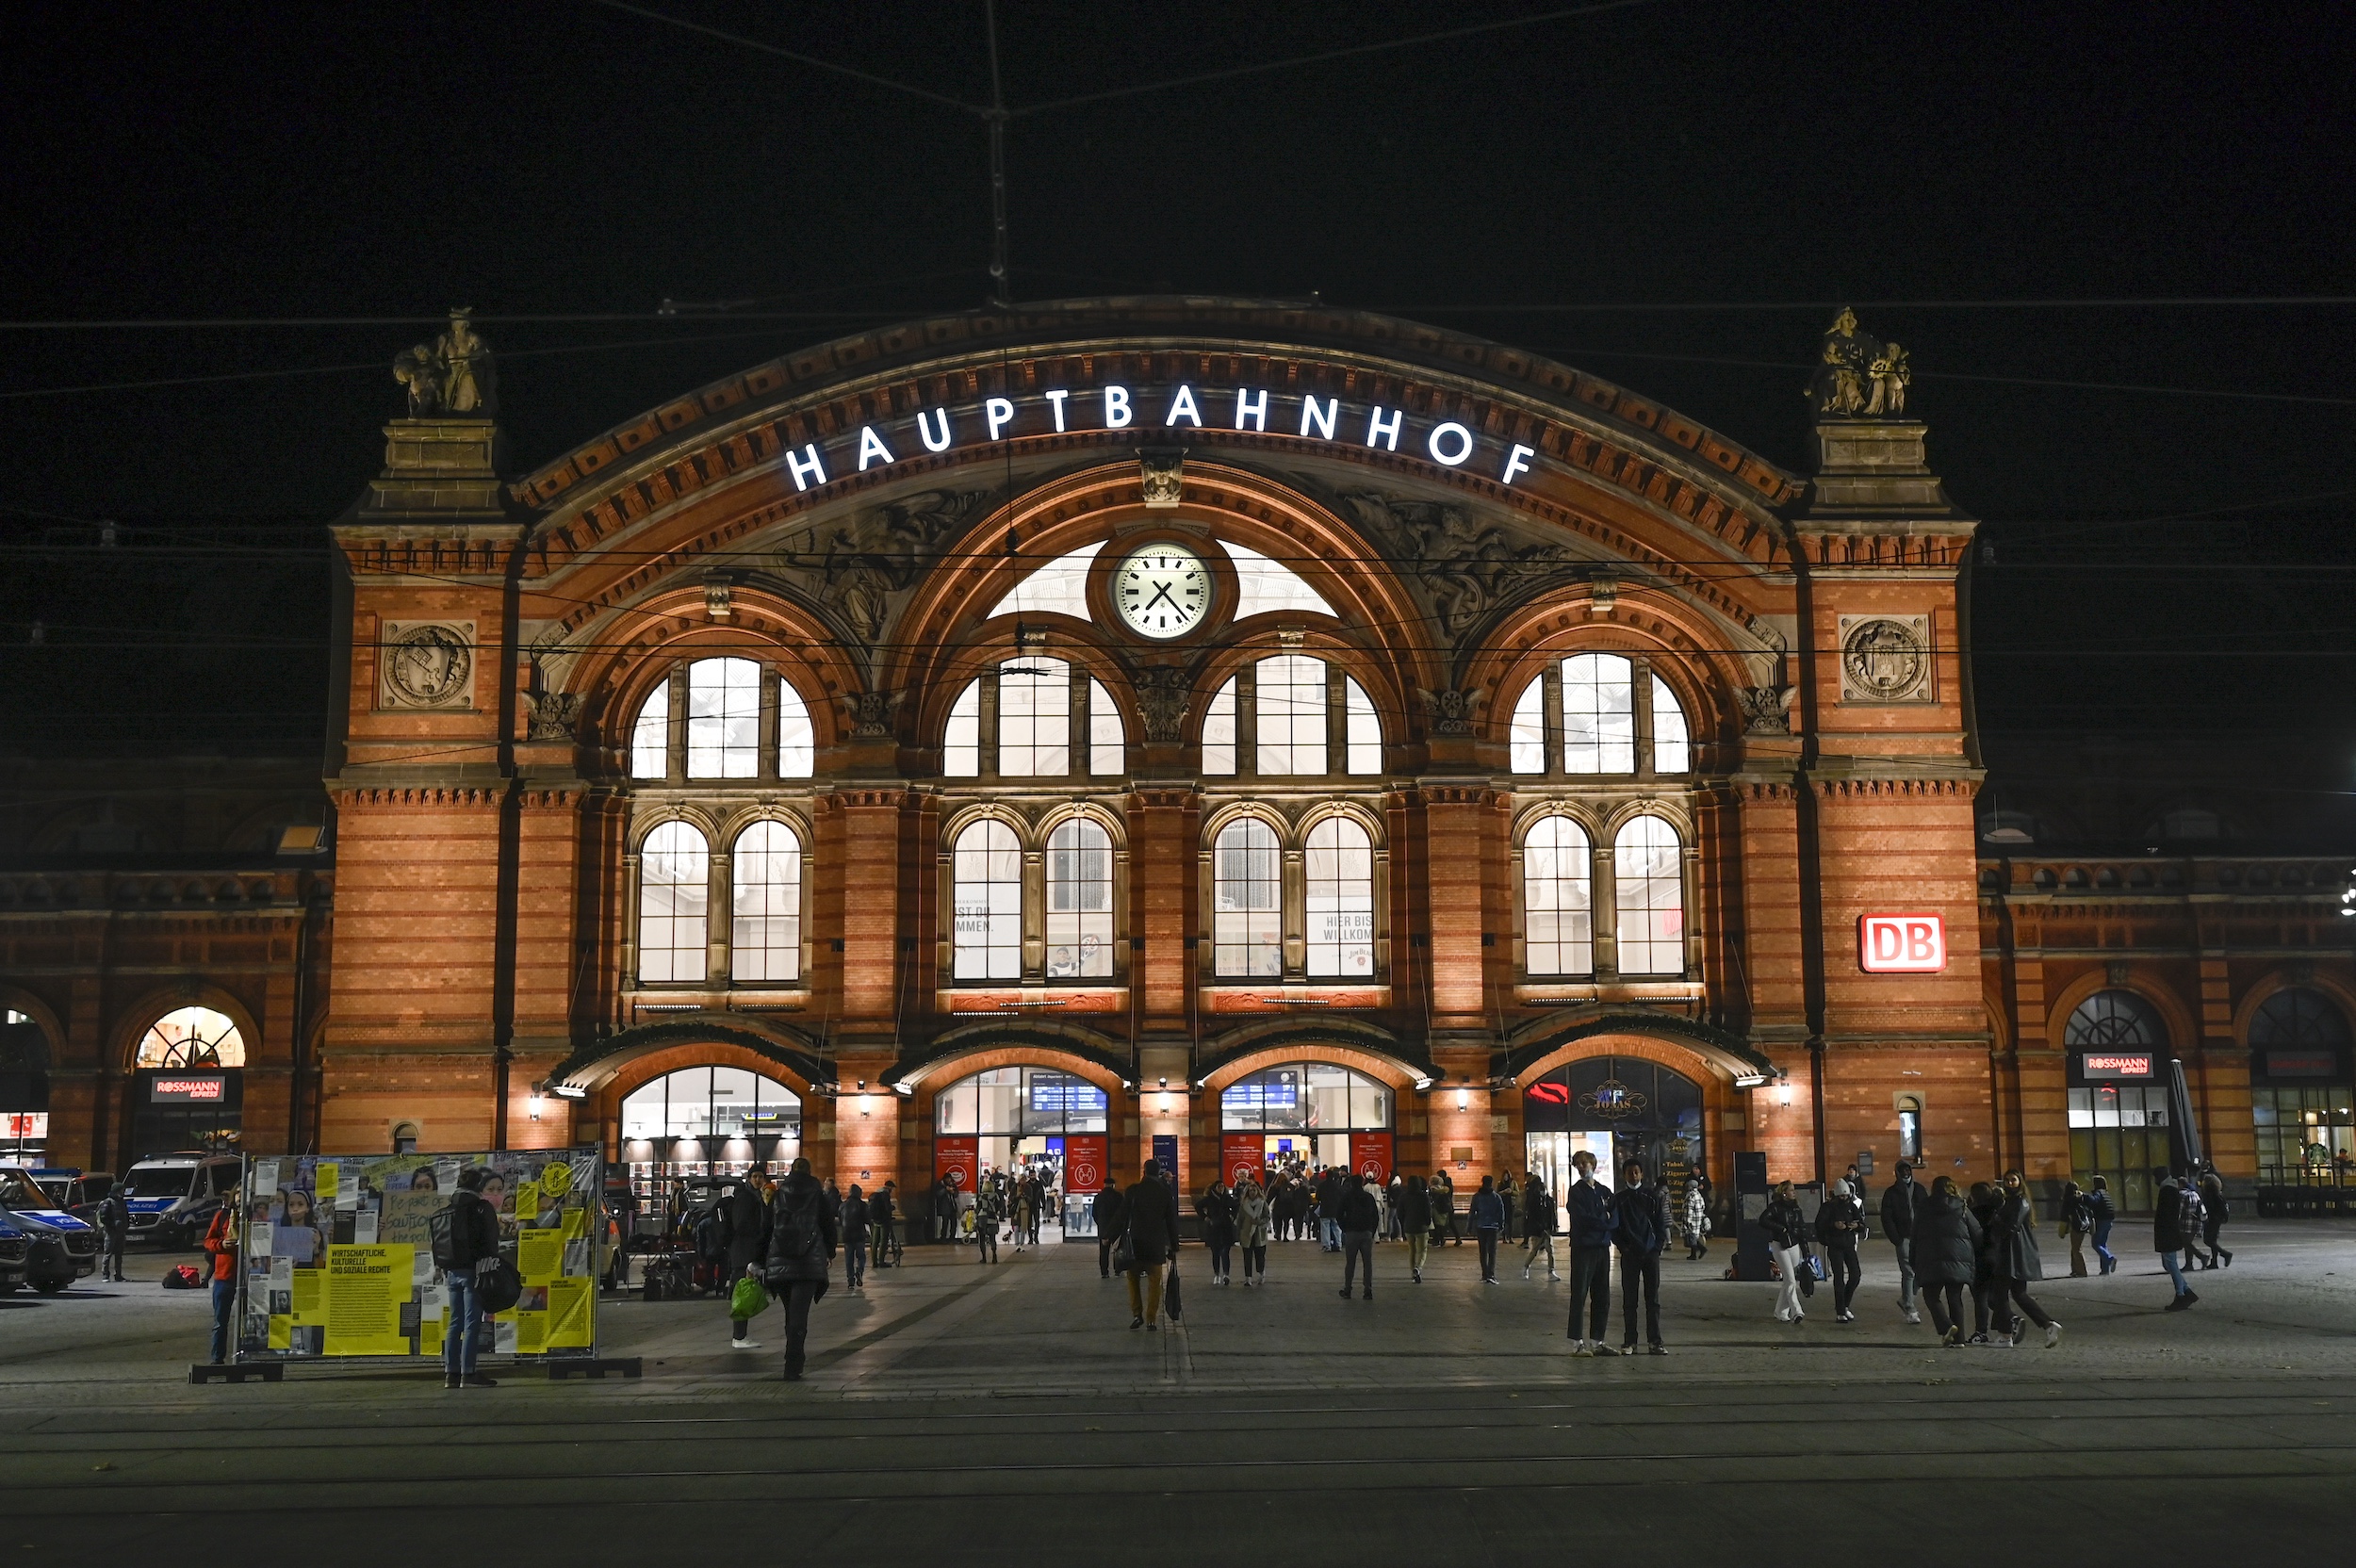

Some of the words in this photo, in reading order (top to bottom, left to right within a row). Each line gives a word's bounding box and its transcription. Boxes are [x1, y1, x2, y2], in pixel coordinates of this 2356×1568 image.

[785, 384, 1535, 492] HAUPTBAHNHOF
[1327, 916, 1350, 927] HIER
[1324, 929, 1372, 940] WILKOM
[1873, 923, 1935, 961] DB
[2088, 1058, 2148, 1069] ROSSMANN
[157, 1082, 220, 1093] ROSSMANN
[1594, 1100, 1631, 1109] JONAS
[332, 1249, 386, 1257] WIRTSCHAFTLICHE,
[368, 1266, 391, 1274] RECHTE
